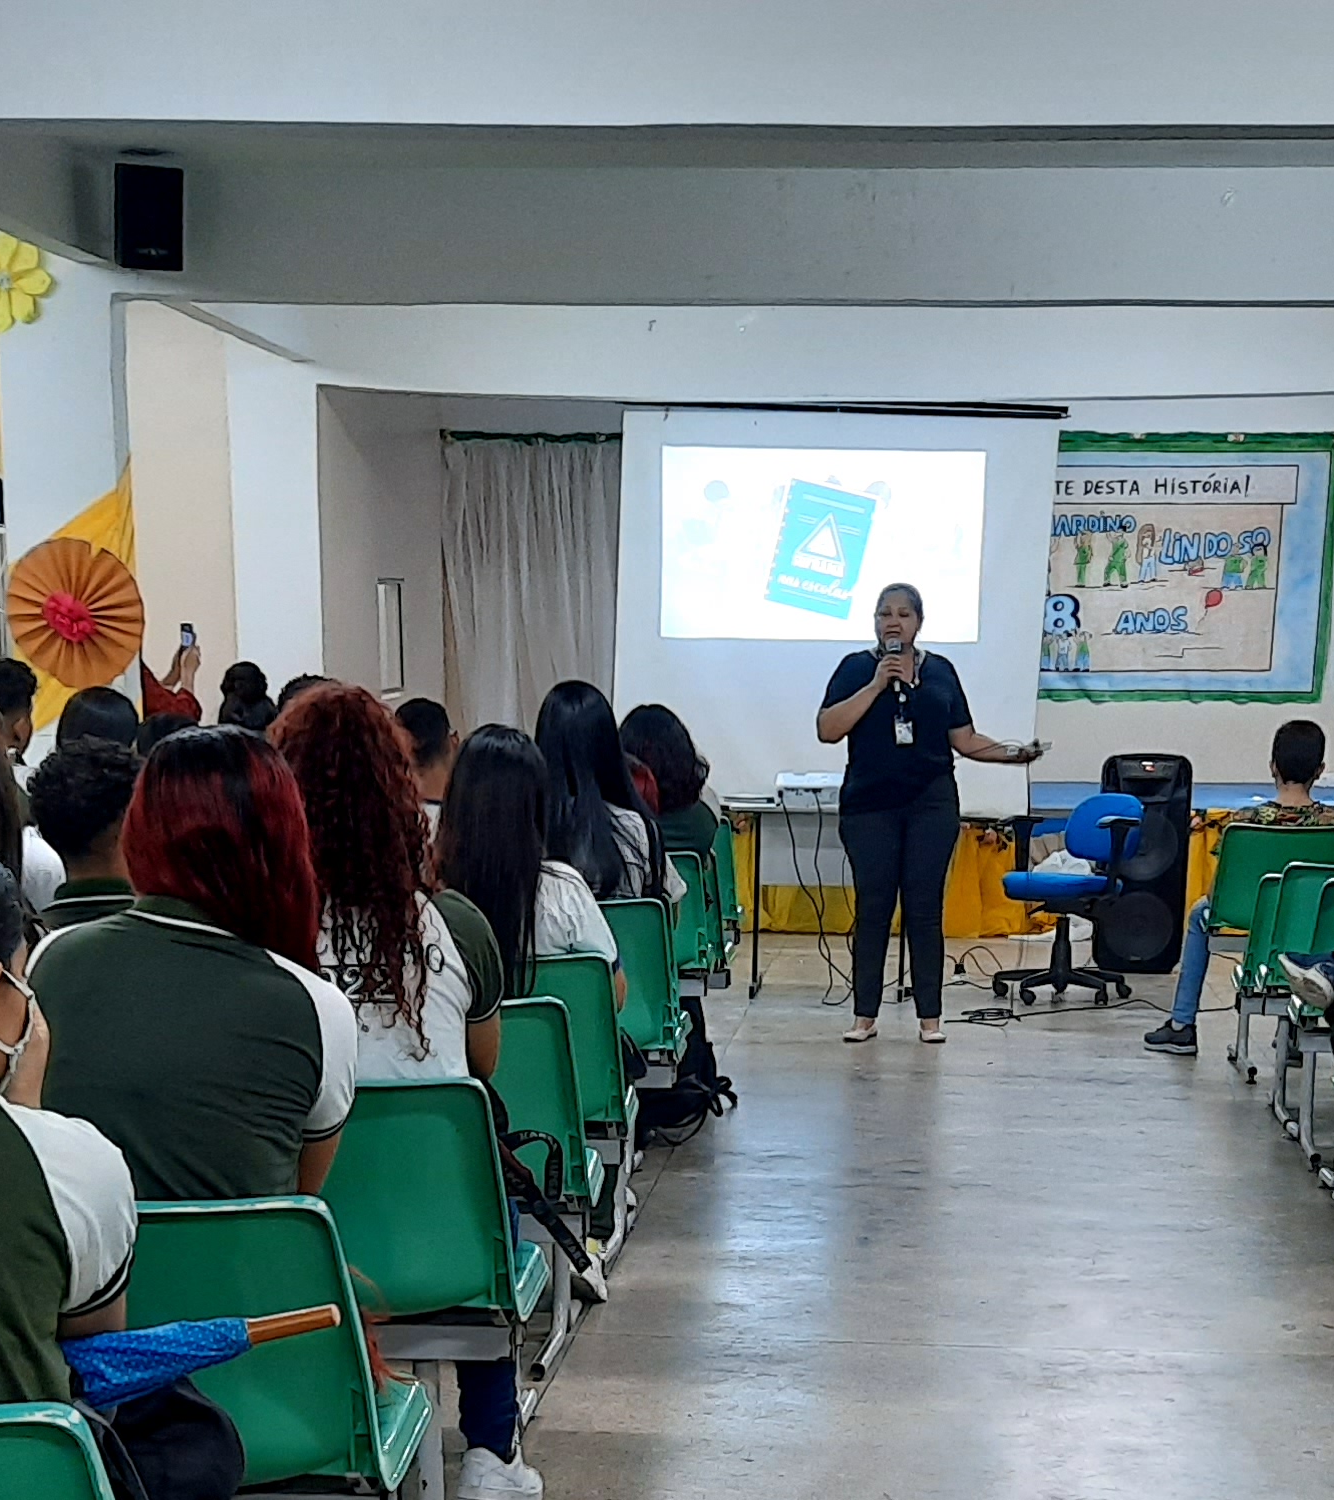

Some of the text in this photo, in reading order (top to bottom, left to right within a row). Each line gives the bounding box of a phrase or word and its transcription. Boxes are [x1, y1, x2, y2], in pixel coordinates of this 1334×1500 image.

[1083, 479, 1140, 496] DESTA
[1051, 510, 1137, 537] ARDINO
[1113, 606, 1188, 634] ANOS
